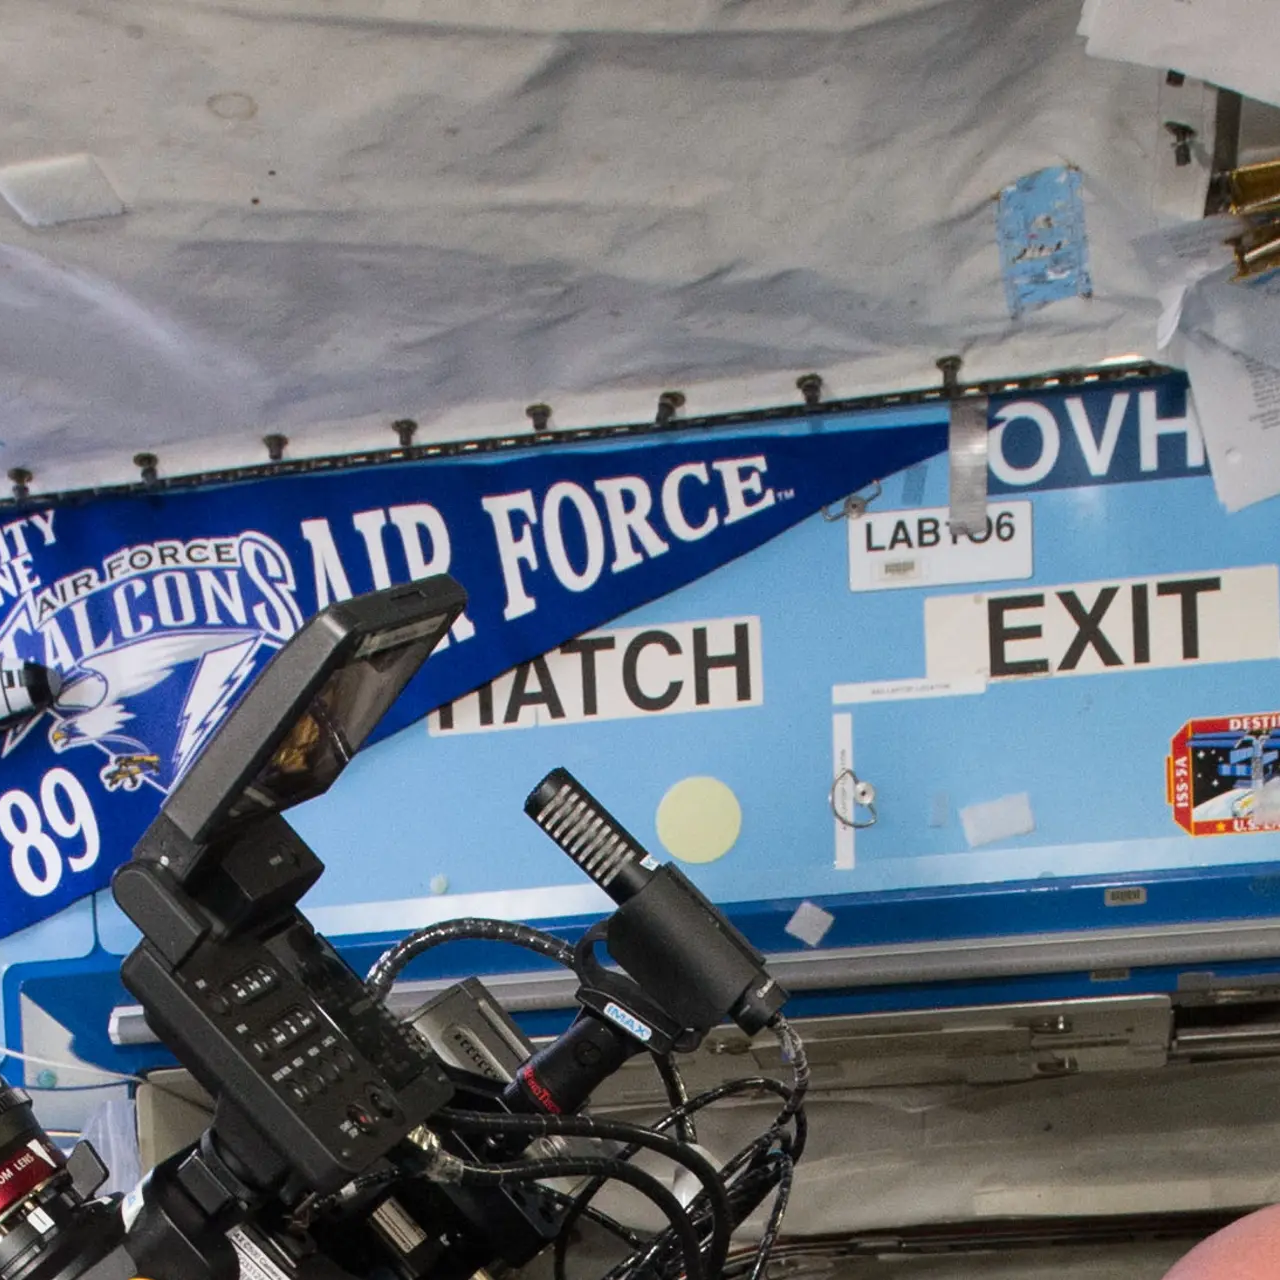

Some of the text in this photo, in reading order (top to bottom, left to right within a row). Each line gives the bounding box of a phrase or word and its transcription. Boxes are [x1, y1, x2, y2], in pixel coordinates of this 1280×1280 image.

[482, 455, 777, 621] FORCE
[36, 541, 238, 621] AIR FORCE
[987, 576, 1222, 678] EXIT
[607, 1004, 649, 1038] IMAX
[14, 1152, 36, 1171] LENS
